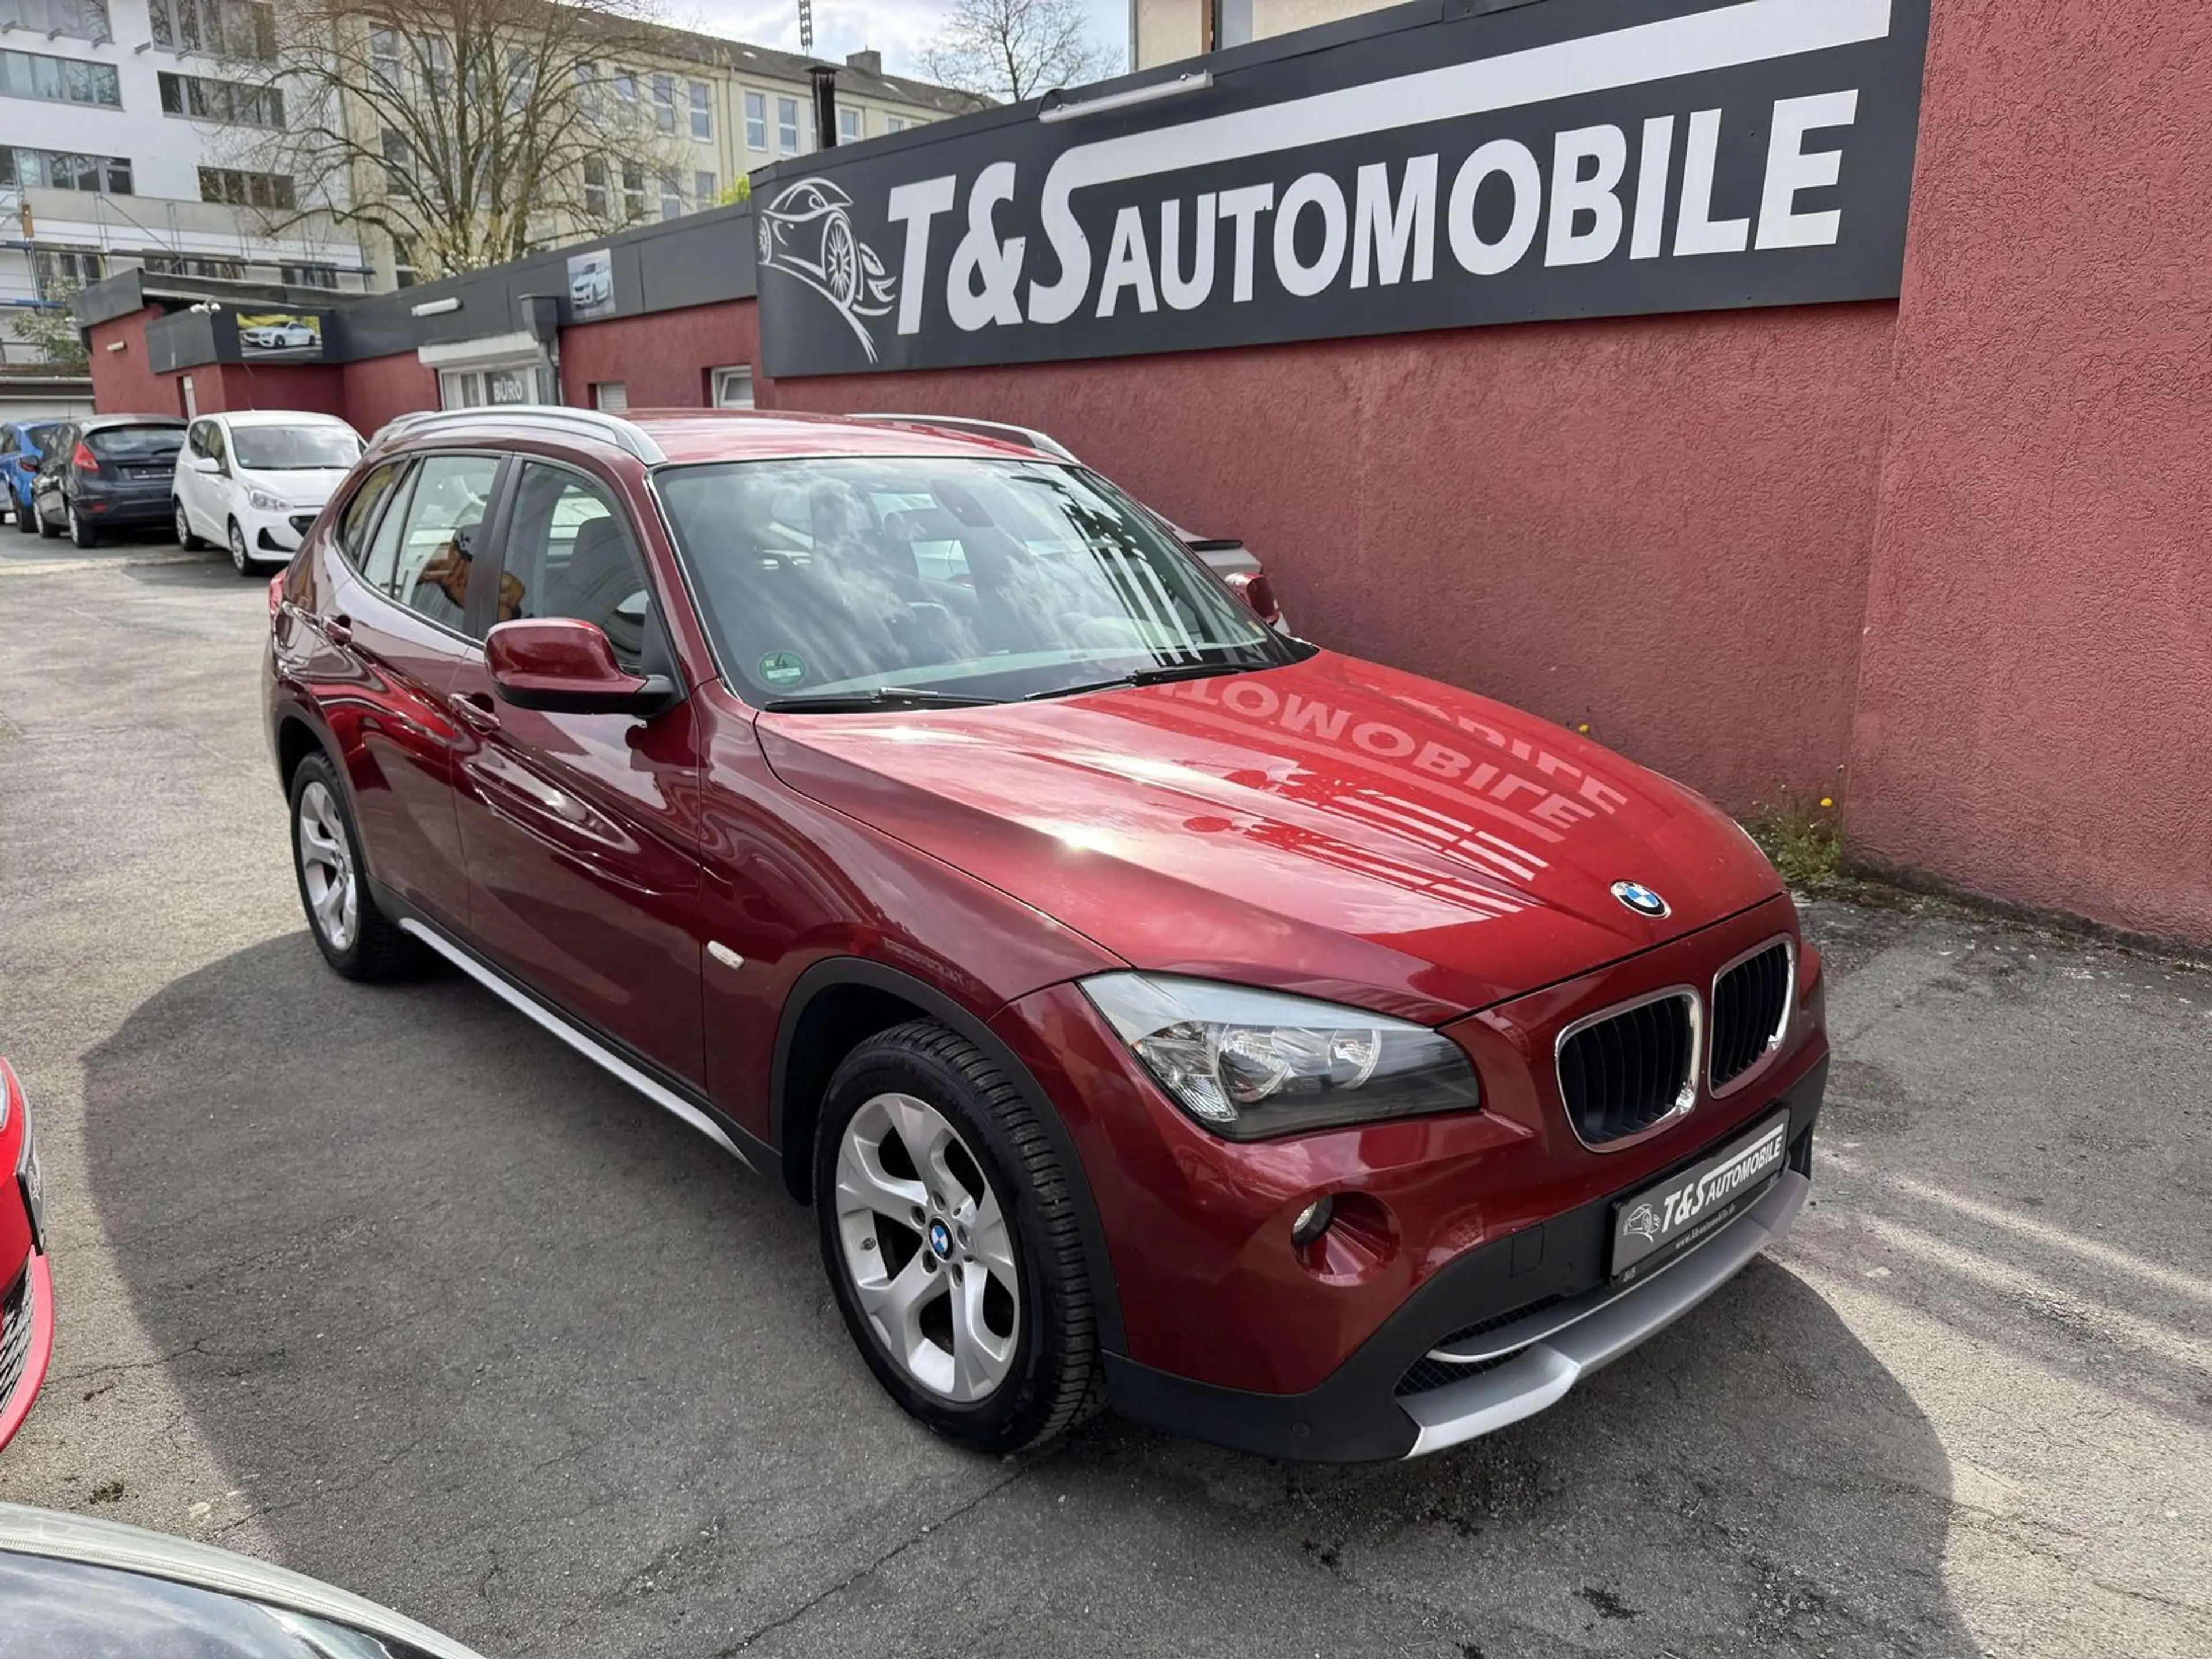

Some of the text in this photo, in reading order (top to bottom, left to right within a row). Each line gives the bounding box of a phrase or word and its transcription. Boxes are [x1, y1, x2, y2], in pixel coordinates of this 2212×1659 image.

[888, 89, 1859, 335] T&S AUTOMOBILE
[493, 377, 522, 402] BÜRO
[1662, 1174, 1705, 1233] T&S
[1706, 1135, 1783, 1206] AUTOMOBILE
